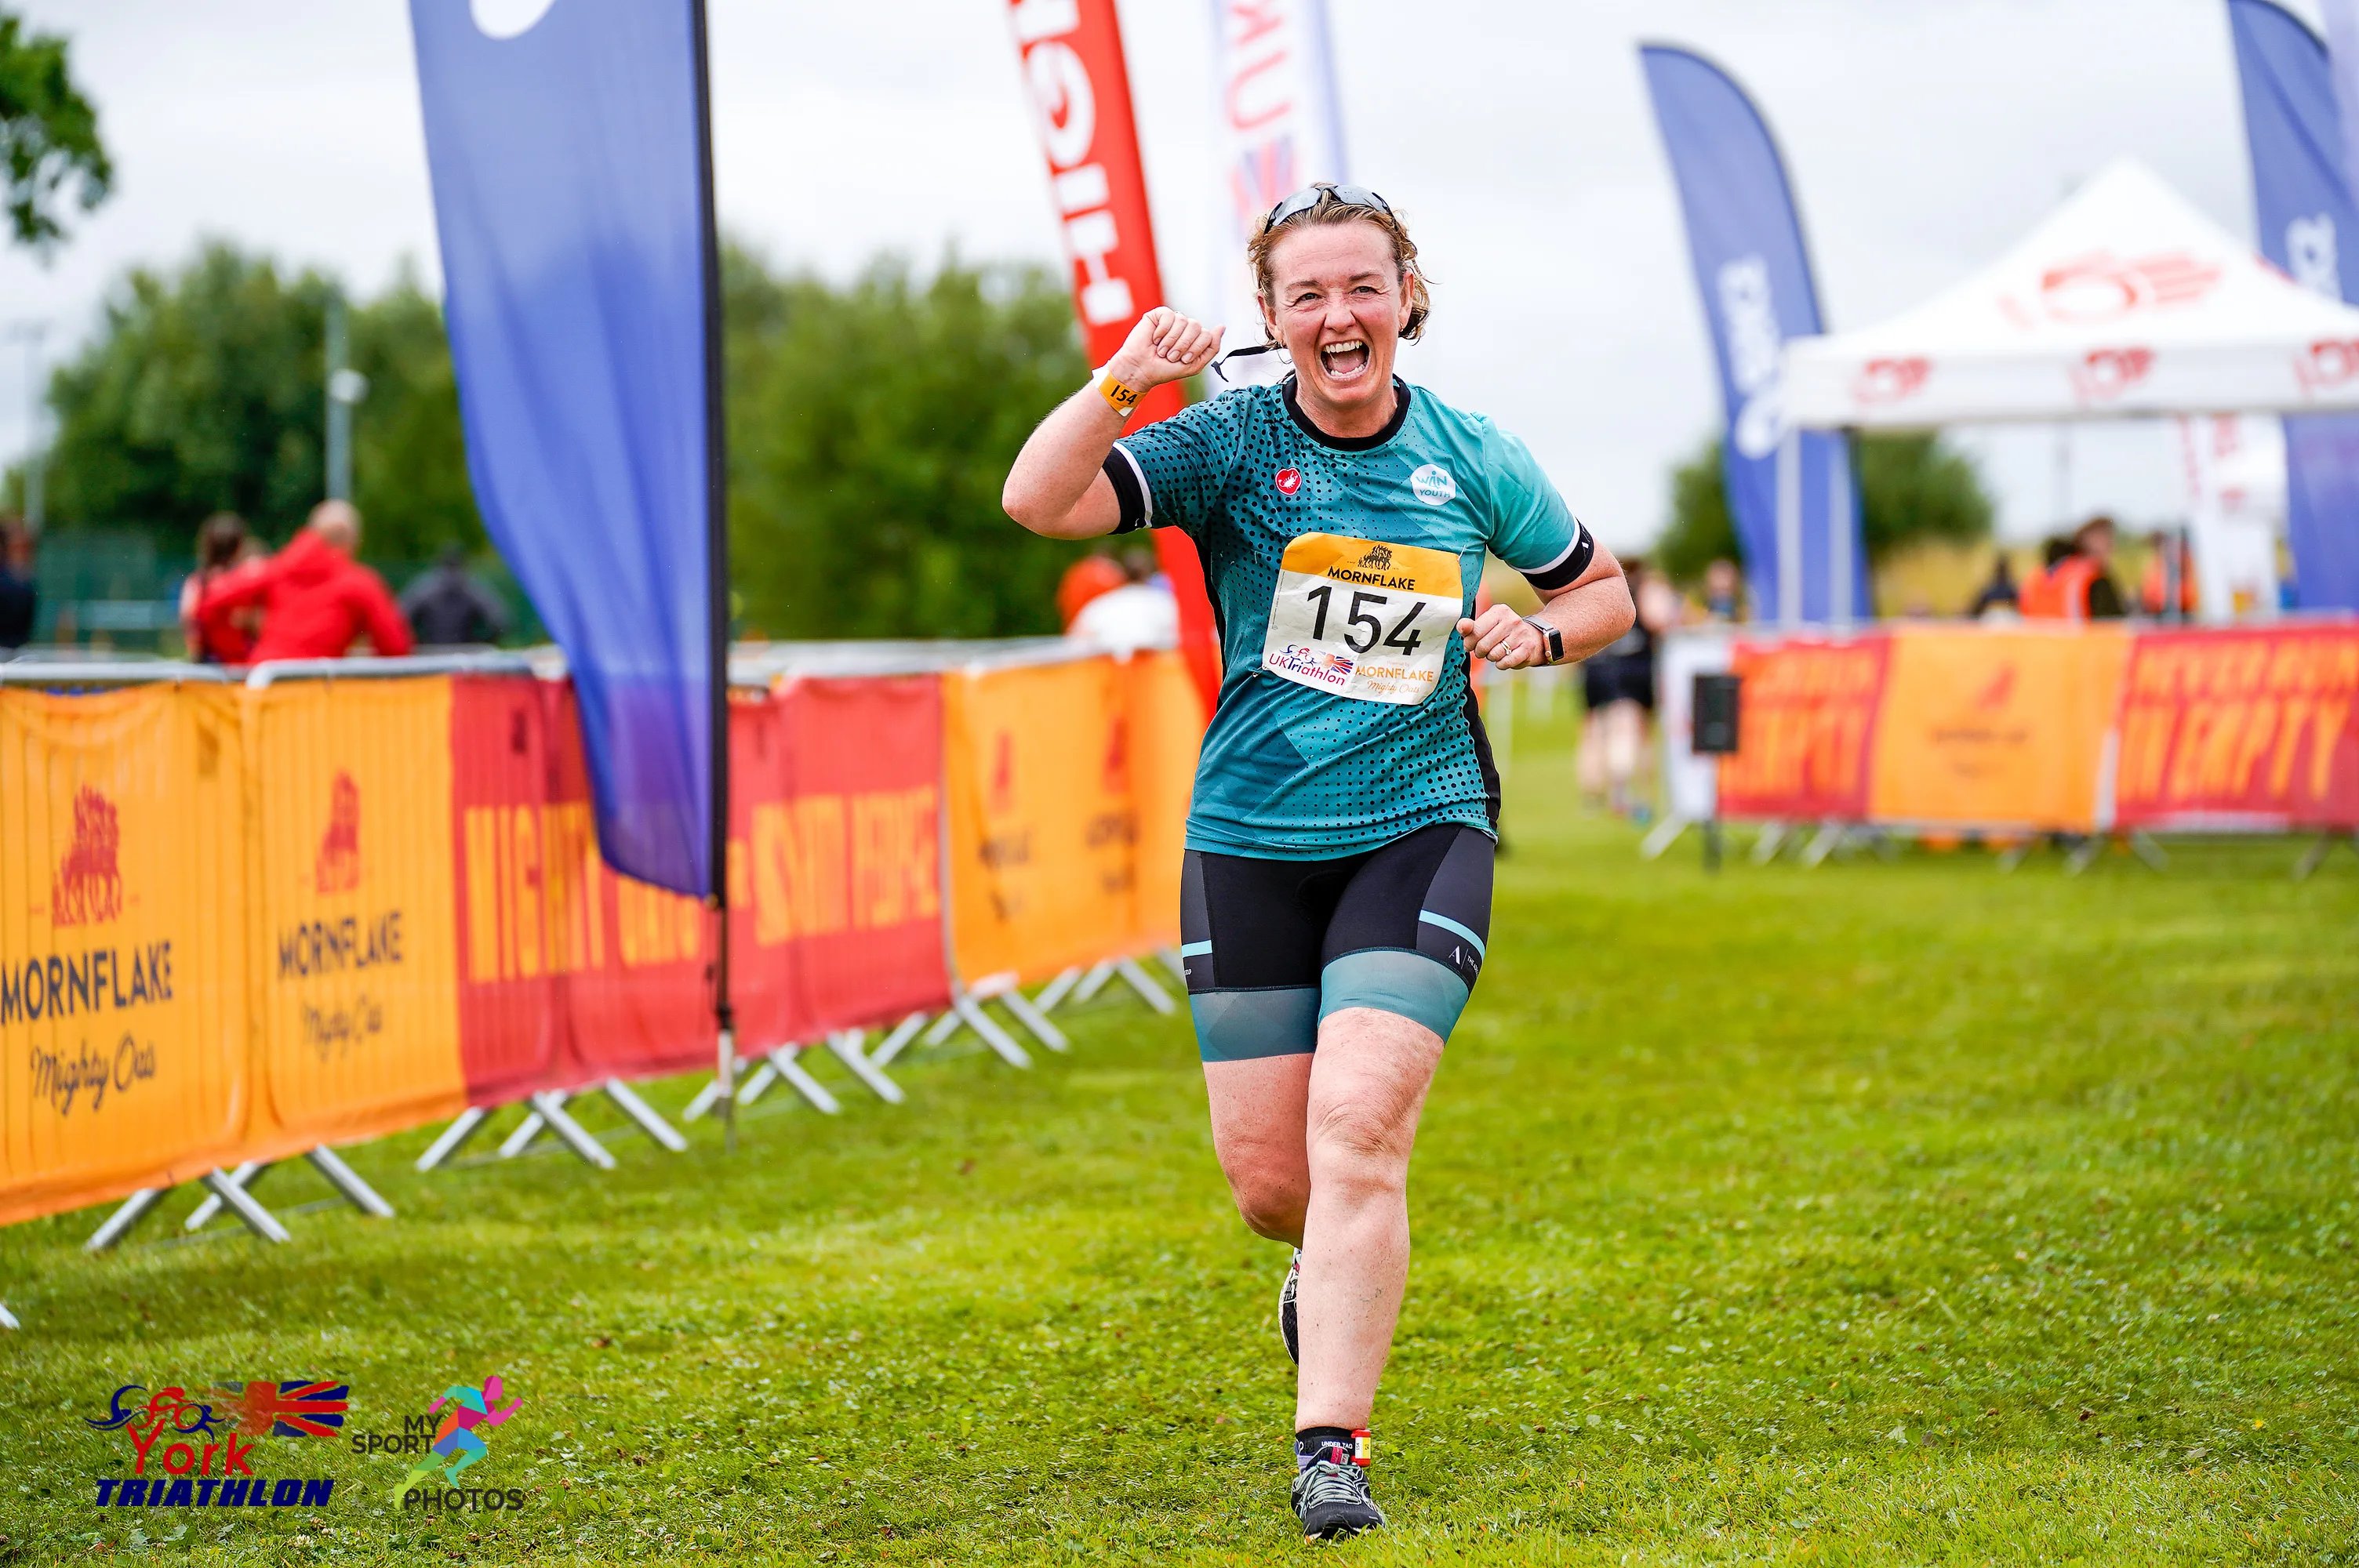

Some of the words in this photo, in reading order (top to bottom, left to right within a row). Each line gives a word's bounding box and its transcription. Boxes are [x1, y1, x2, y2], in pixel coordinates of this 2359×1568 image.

[1110, 384, 1138, 405] 154
[1419, 489, 1450, 499] YOUTH
[1327, 565, 1416, 590] MORNFLAKE
[1307, 585, 1427, 655] 154
[1268, 652, 1346, 686] UKTriathlon
[1355, 666, 1434, 682] MORNFLAKE
[1367, 680, 1397, 695] Mighty
[1399, 683, 1419, 694] Oats
[277, 911, 402, 982] MORNFLAKE
[0, 939, 172, 1025] MORNFLAKE
[30, 1038, 109, 1117] Mighty
